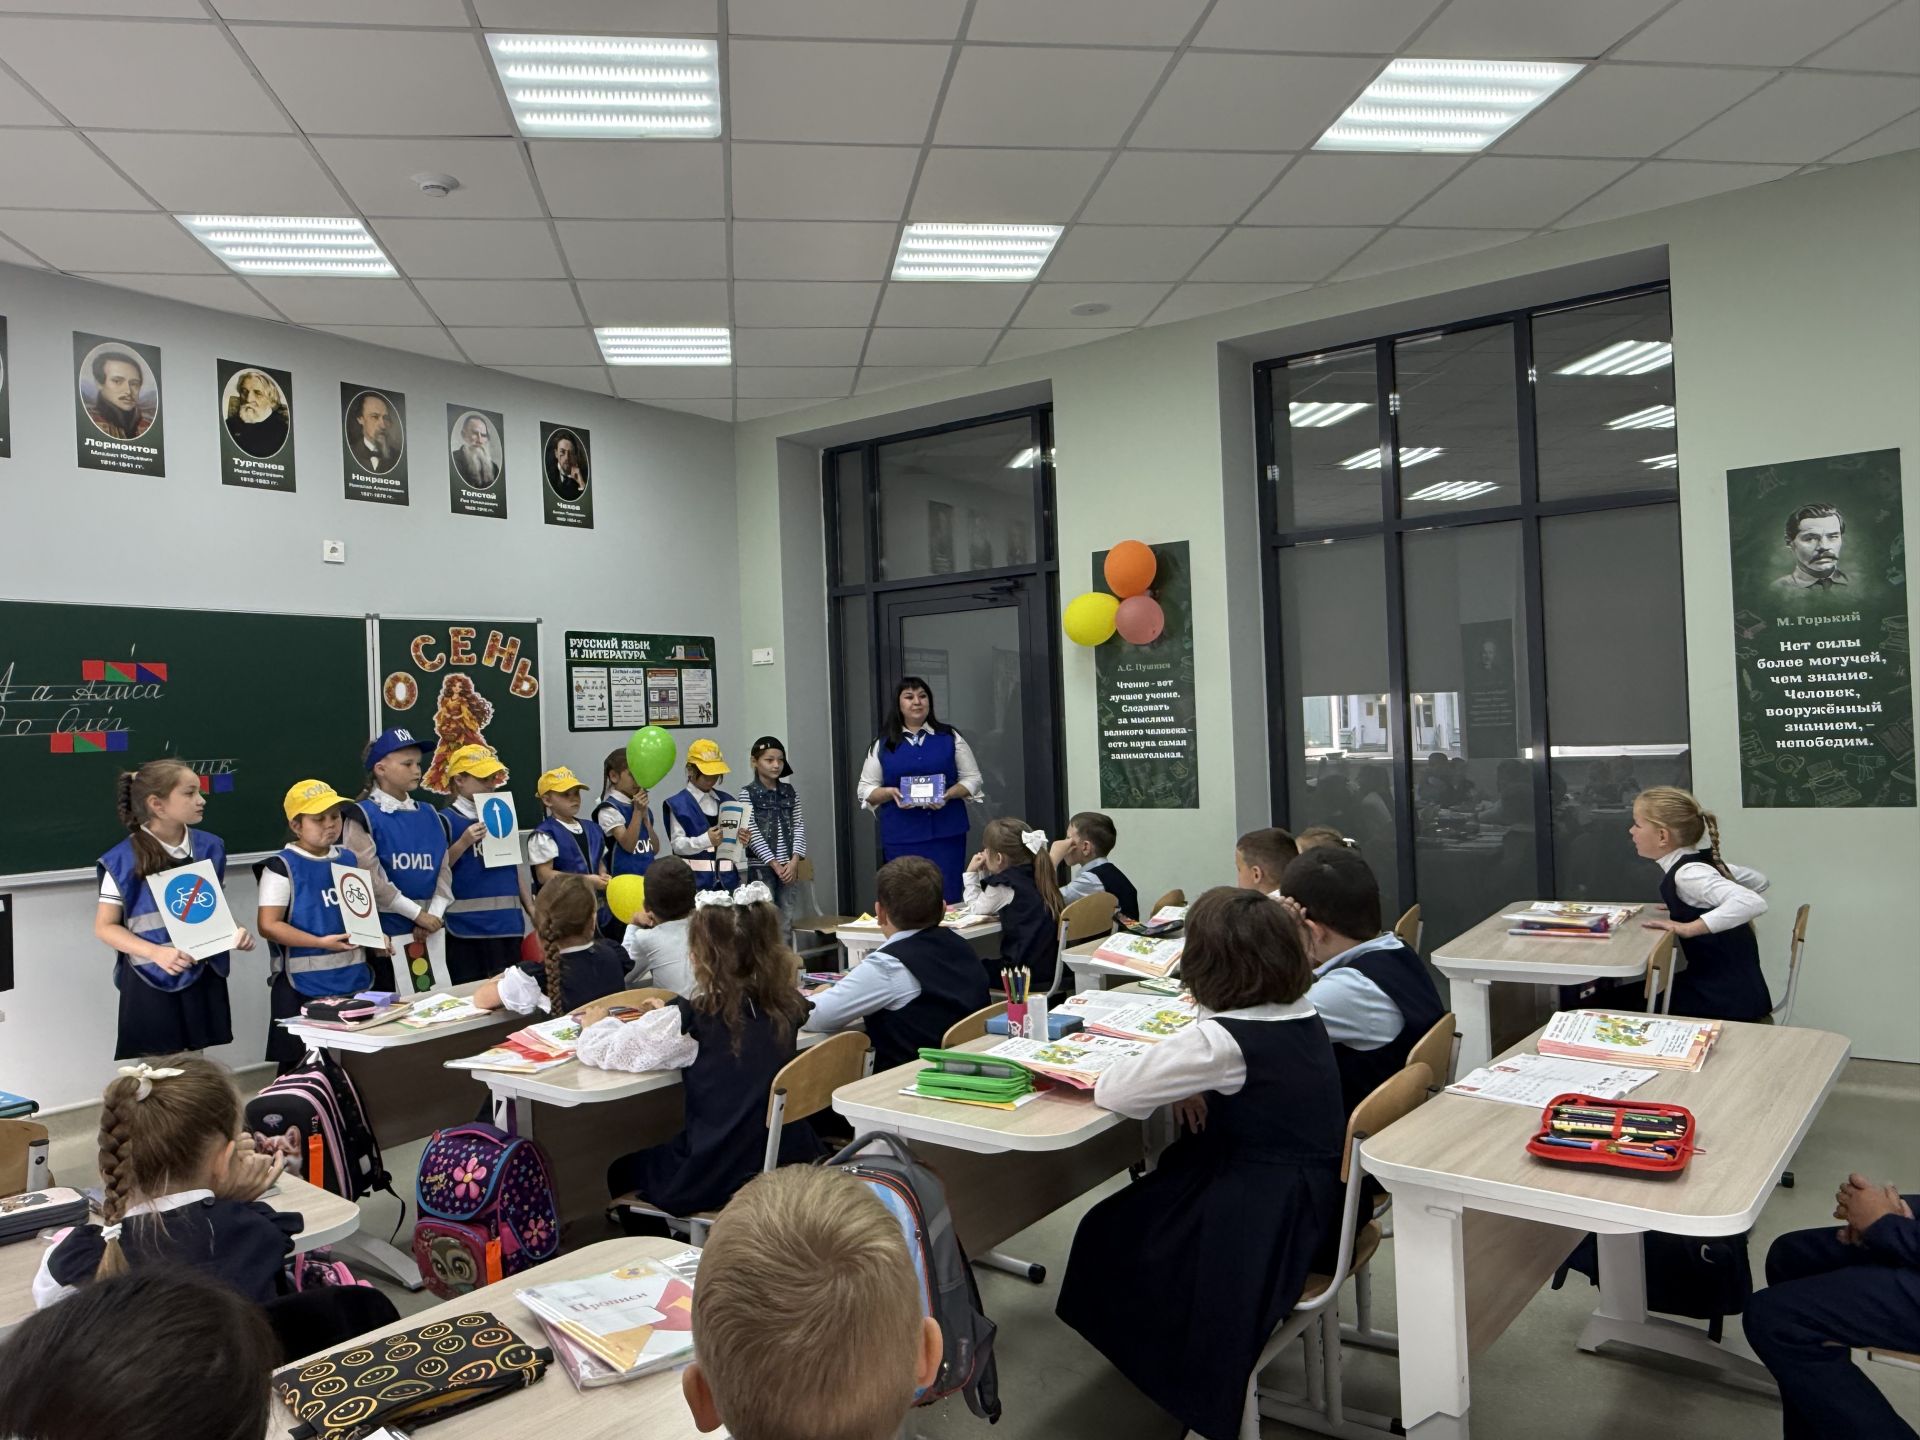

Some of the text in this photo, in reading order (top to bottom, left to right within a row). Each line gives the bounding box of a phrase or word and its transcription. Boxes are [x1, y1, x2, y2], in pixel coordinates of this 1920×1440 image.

[84, 437, 158, 455] Лермонтов
[232, 457, 285, 471] Тургенев
[351, 473, 401, 486] Некрасов
[460, 489, 497, 500] Толстой
[556, 502, 581, 511] Чехов
[1776, 612, 1861, 627] М. Горький
[569, 638, 651, 650] РУССКИЙ ЯЗЫК
[1780, 638, 1861, 652] Нет силы
[570, 649, 647, 660] И ЛИТЕРАТУРА
[1757, 651, 1888, 669] более могучей,
[1770, 670, 1874, 684] чем знание.
[1116, 680, 1150, 689] Чтение
[1109, 691, 1181, 703] лучшее учение.
[1784, 687, 1861, 699] Человек,
[1121, 704, 1170, 713] Следовать
[1765, 701, 1883, 718] вооружённый
[1130, 715, 1175, 724] мыслями
[1104, 729, 1144, 737] великого
[1145, 727, 1188, 735] человека
[1784, 721, 1863, 732] знанием,
[1129, 740, 1156, 749] наука
[1776, 736, 1875, 749] непобедим.
[1110, 751, 1184, 760] занимательная.
[392, 852, 435, 871] ЮИД
[567, 1293, 648, 1313] Прописи
